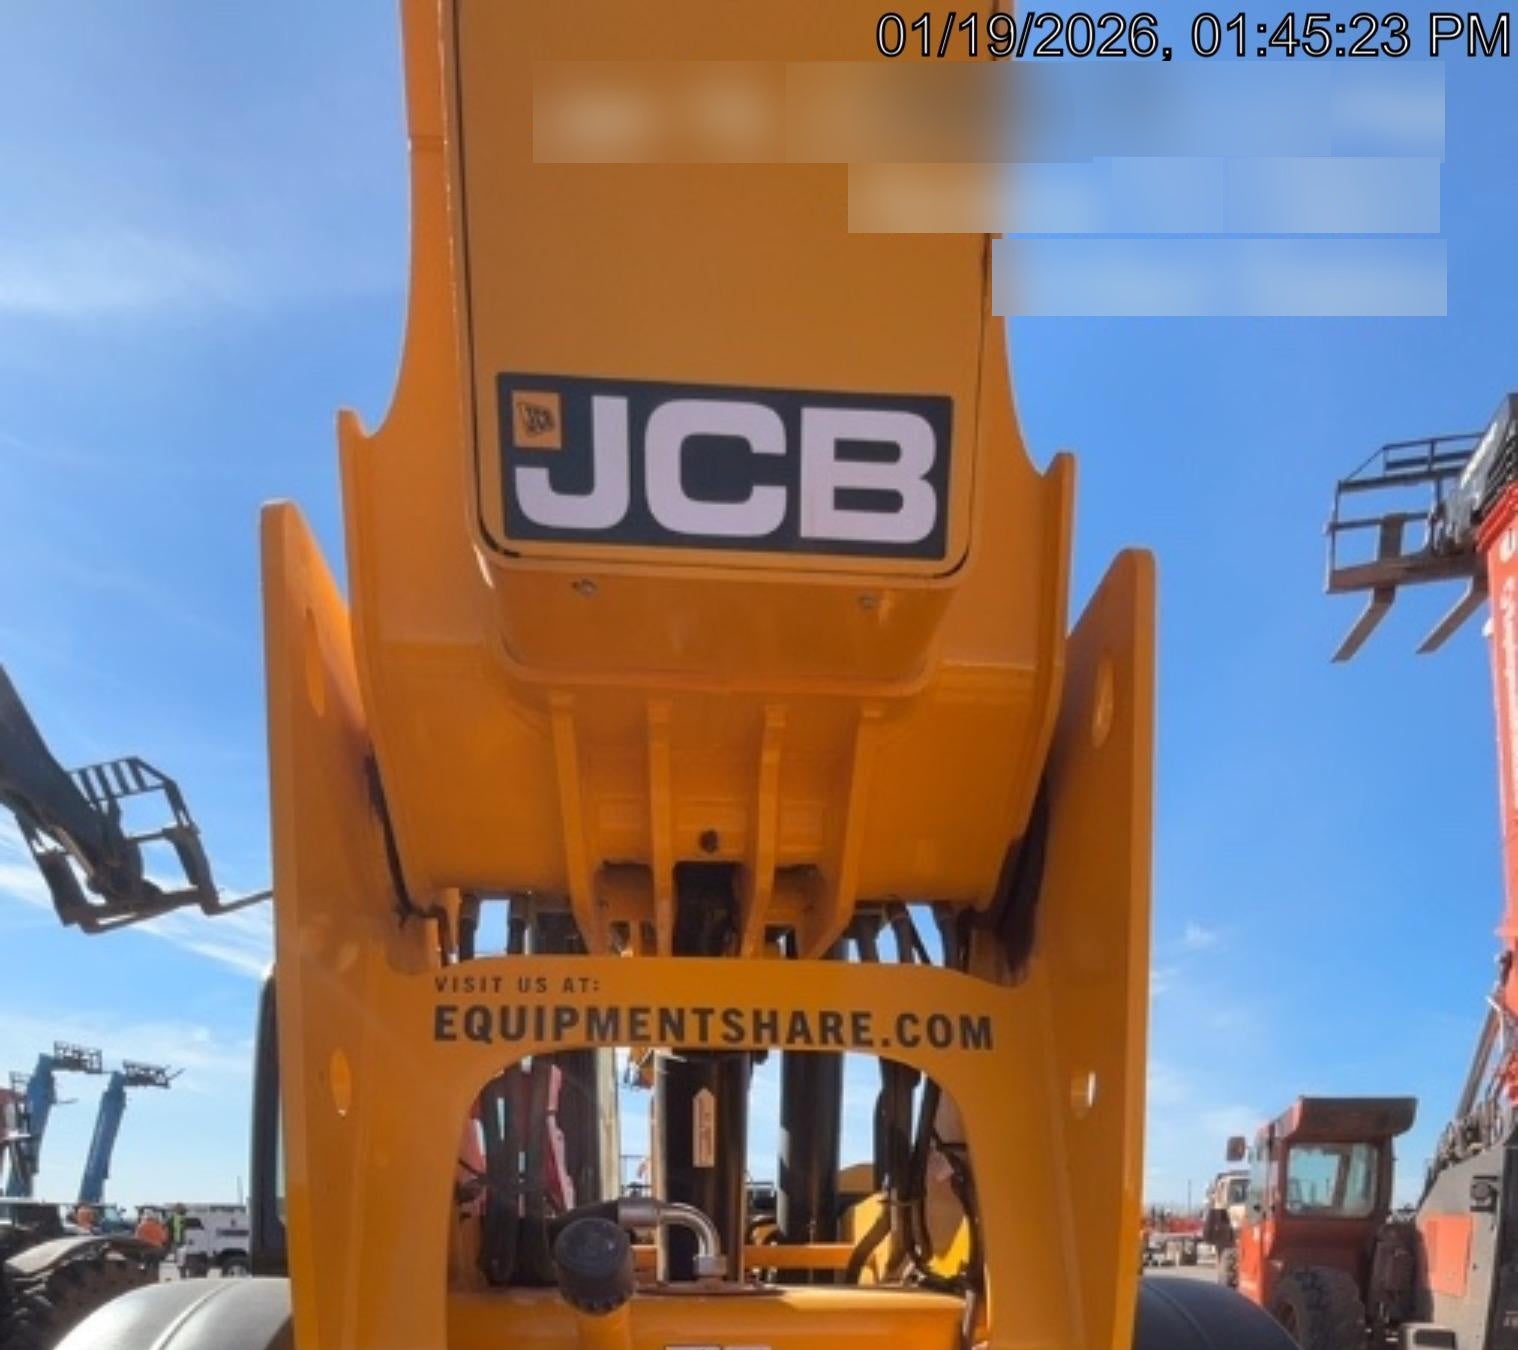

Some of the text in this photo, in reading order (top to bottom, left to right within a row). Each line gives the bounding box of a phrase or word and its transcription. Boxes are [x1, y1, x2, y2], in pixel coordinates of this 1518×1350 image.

[514, 395, 938, 543] JCB
[434, 977, 600, 993] VISIT US AT:
[434, 1005, 993, 1050] EQUIPMENTSHARE.COM
